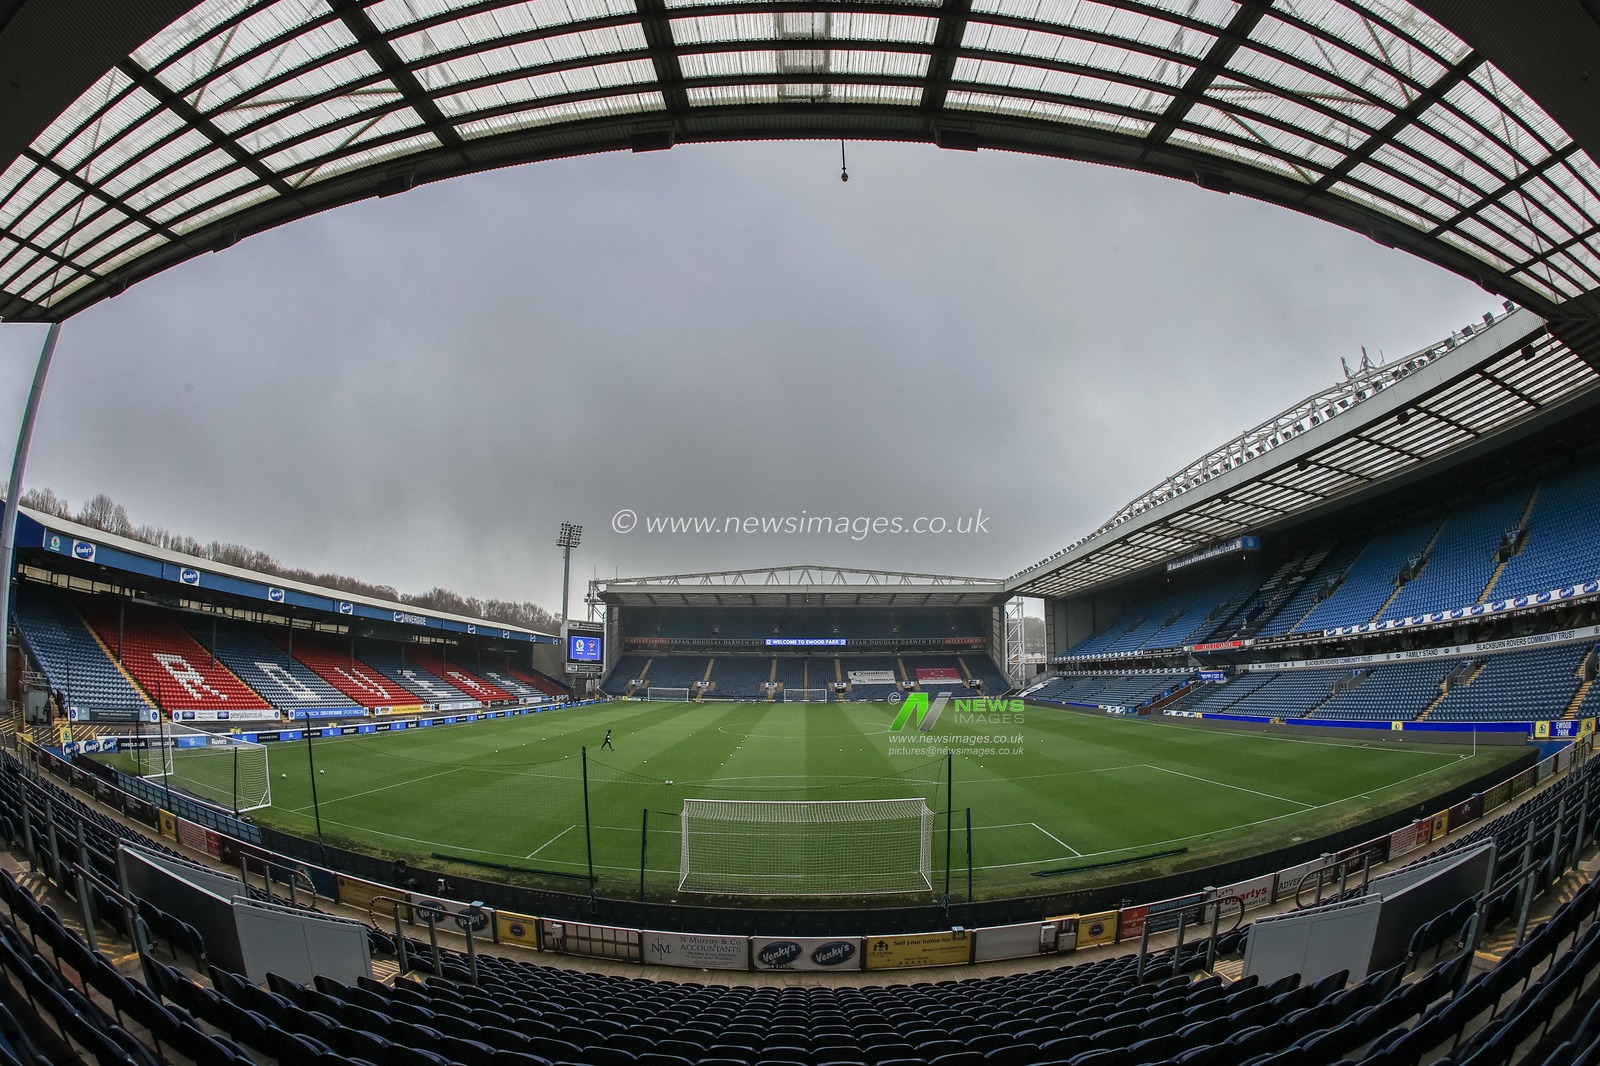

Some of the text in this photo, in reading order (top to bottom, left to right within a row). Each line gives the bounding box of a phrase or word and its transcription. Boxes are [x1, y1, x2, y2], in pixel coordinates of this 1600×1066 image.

[1224, 544, 1235, 552] CLUB
[404, 613, 427, 626] RIVERSIDE
[1476, 630, 1575, 651] BLACKBURN ROVERS COMMUNITY TRUST
[1405, 648, 1438, 658] FAMILY STAND
[1305, 659, 1325, 667] BLACKBURN
[1555, 721, 1572, 730] EWOOD
[1219, 886, 1268, 906] ogartys
[689, 937, 719, 946] Murray
[729, 938, 741, 946] Co
[680, 944, 742, 953] ACCOUNTANTS
[762, 944, 797, 963] Venky's
[815, 944, 850, 963] Venky's
